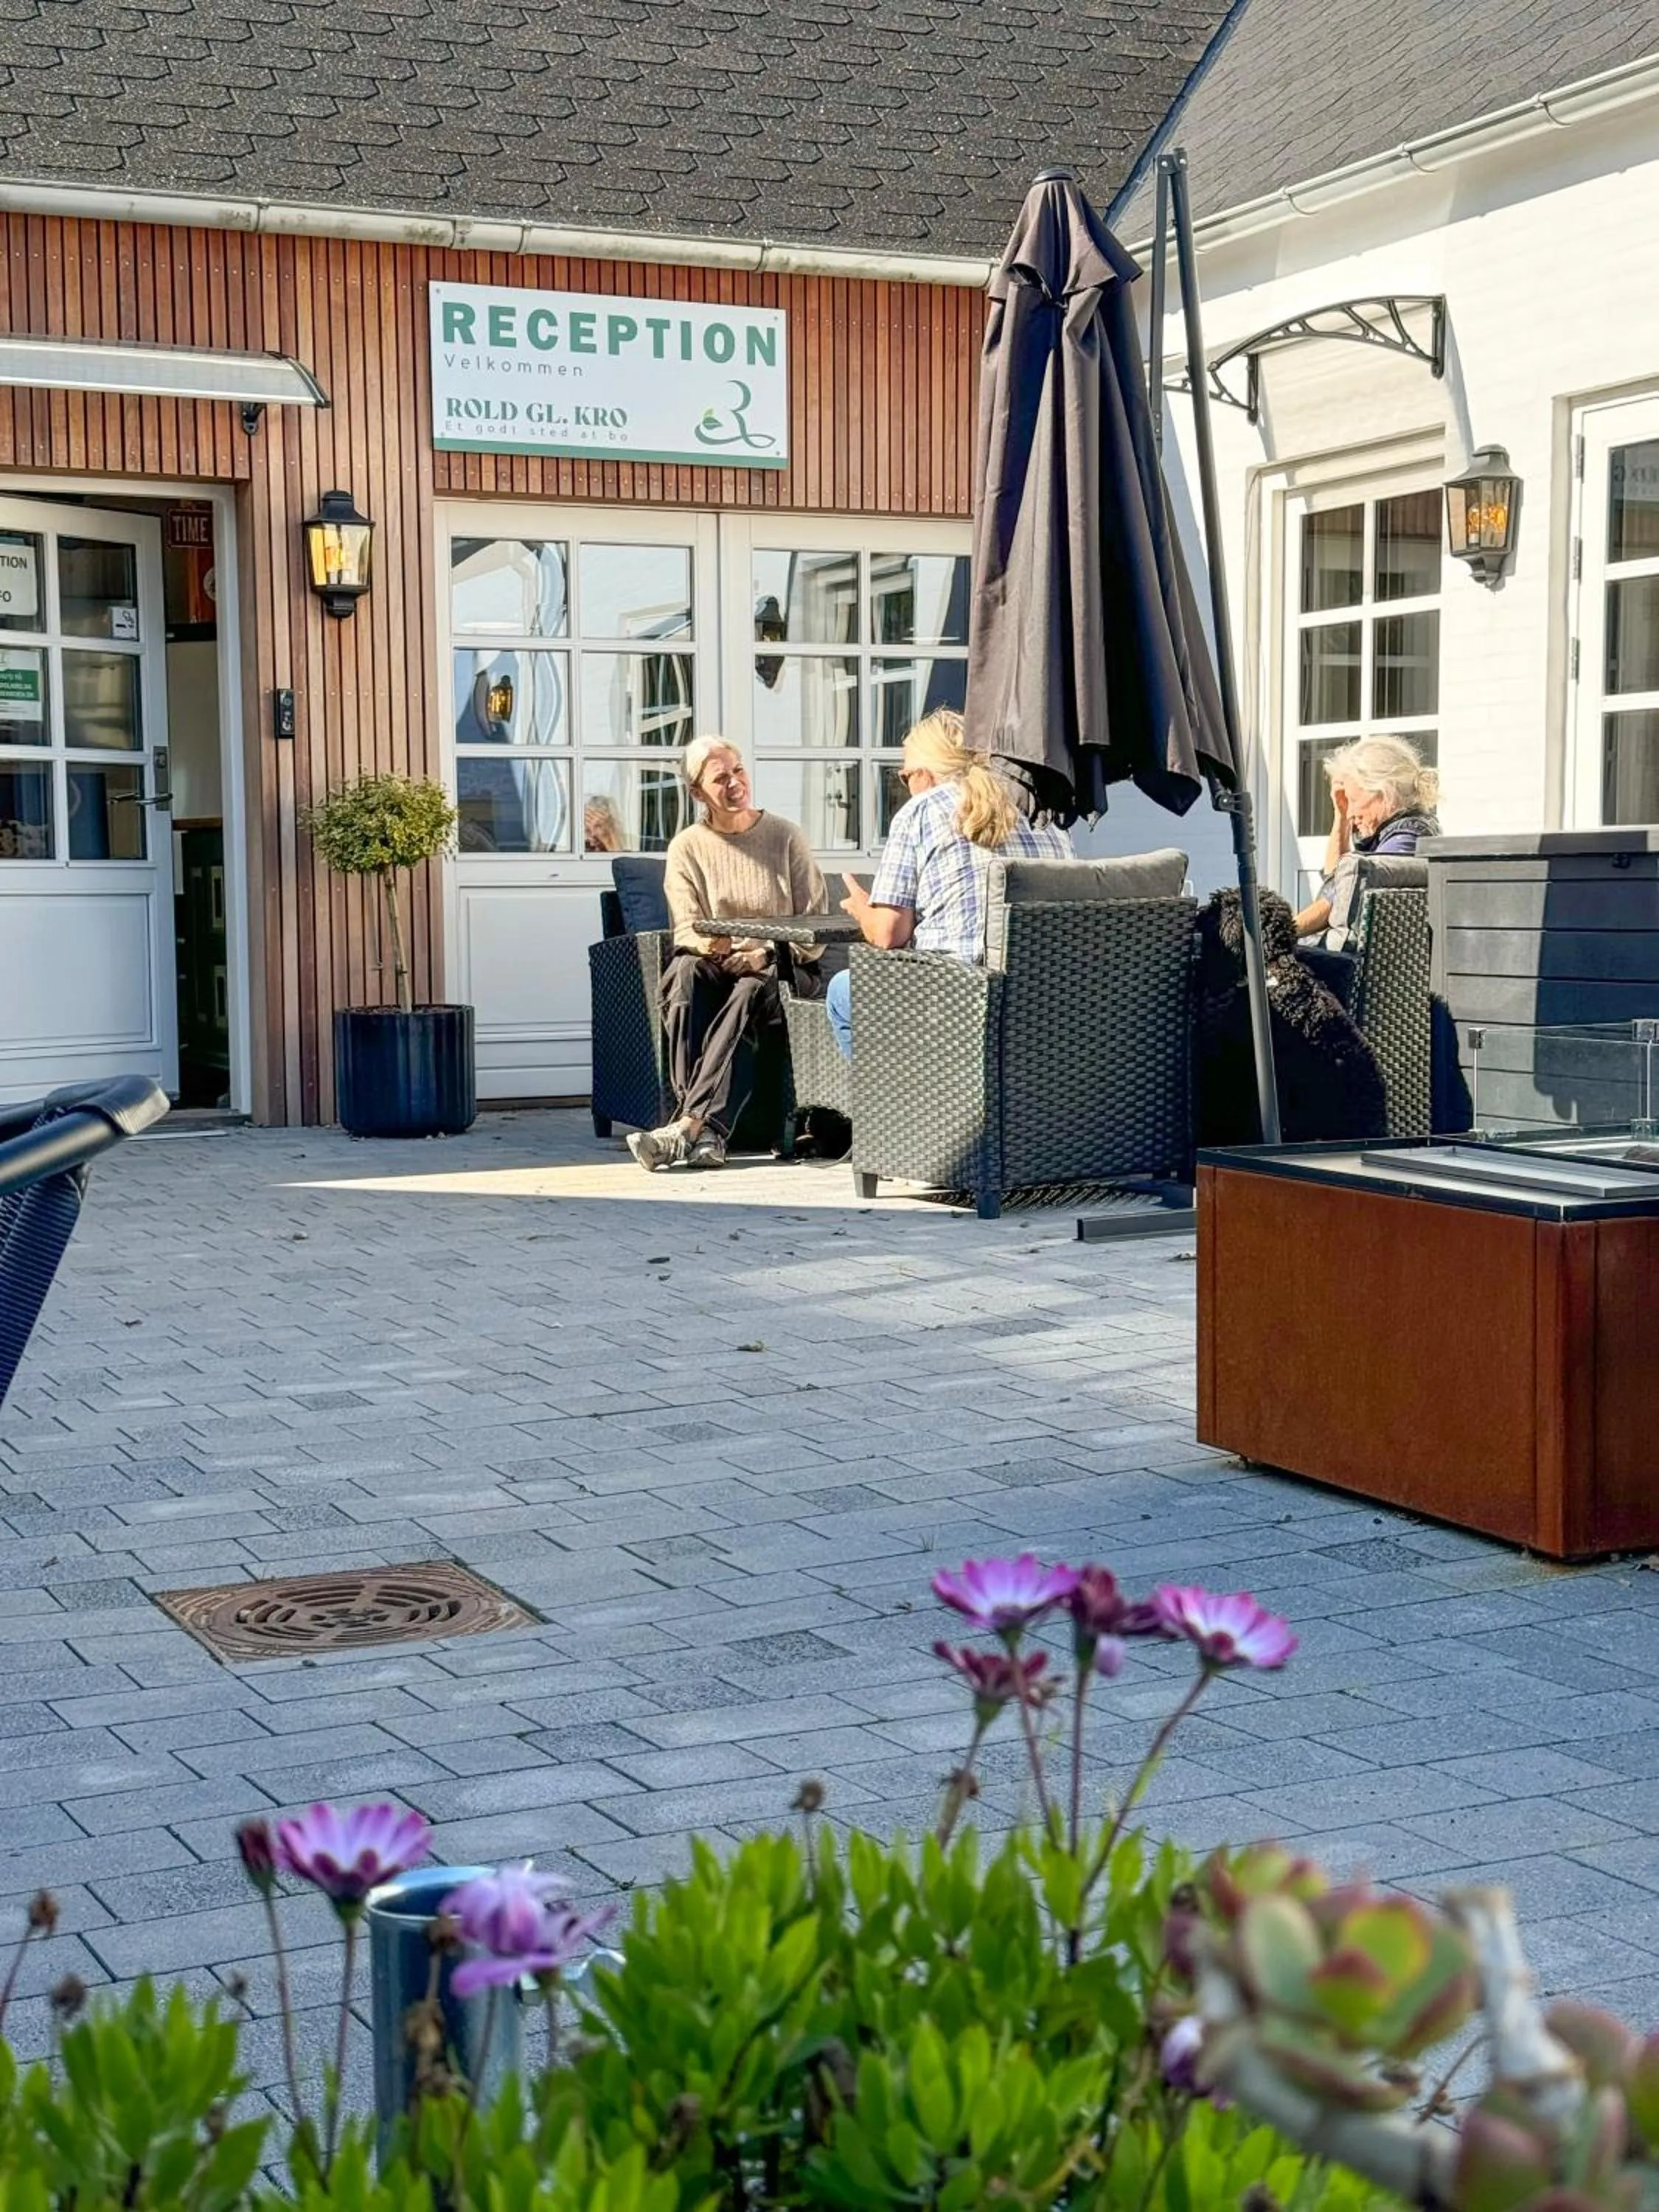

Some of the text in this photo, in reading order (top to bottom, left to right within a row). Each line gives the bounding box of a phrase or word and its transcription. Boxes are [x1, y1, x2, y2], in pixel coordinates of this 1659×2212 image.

[442, 302, 776, 366] RECEPTION
[445, 354, 584, 377] Velkommen
[446, 397, 627, 428] ROLD GL. KRO
